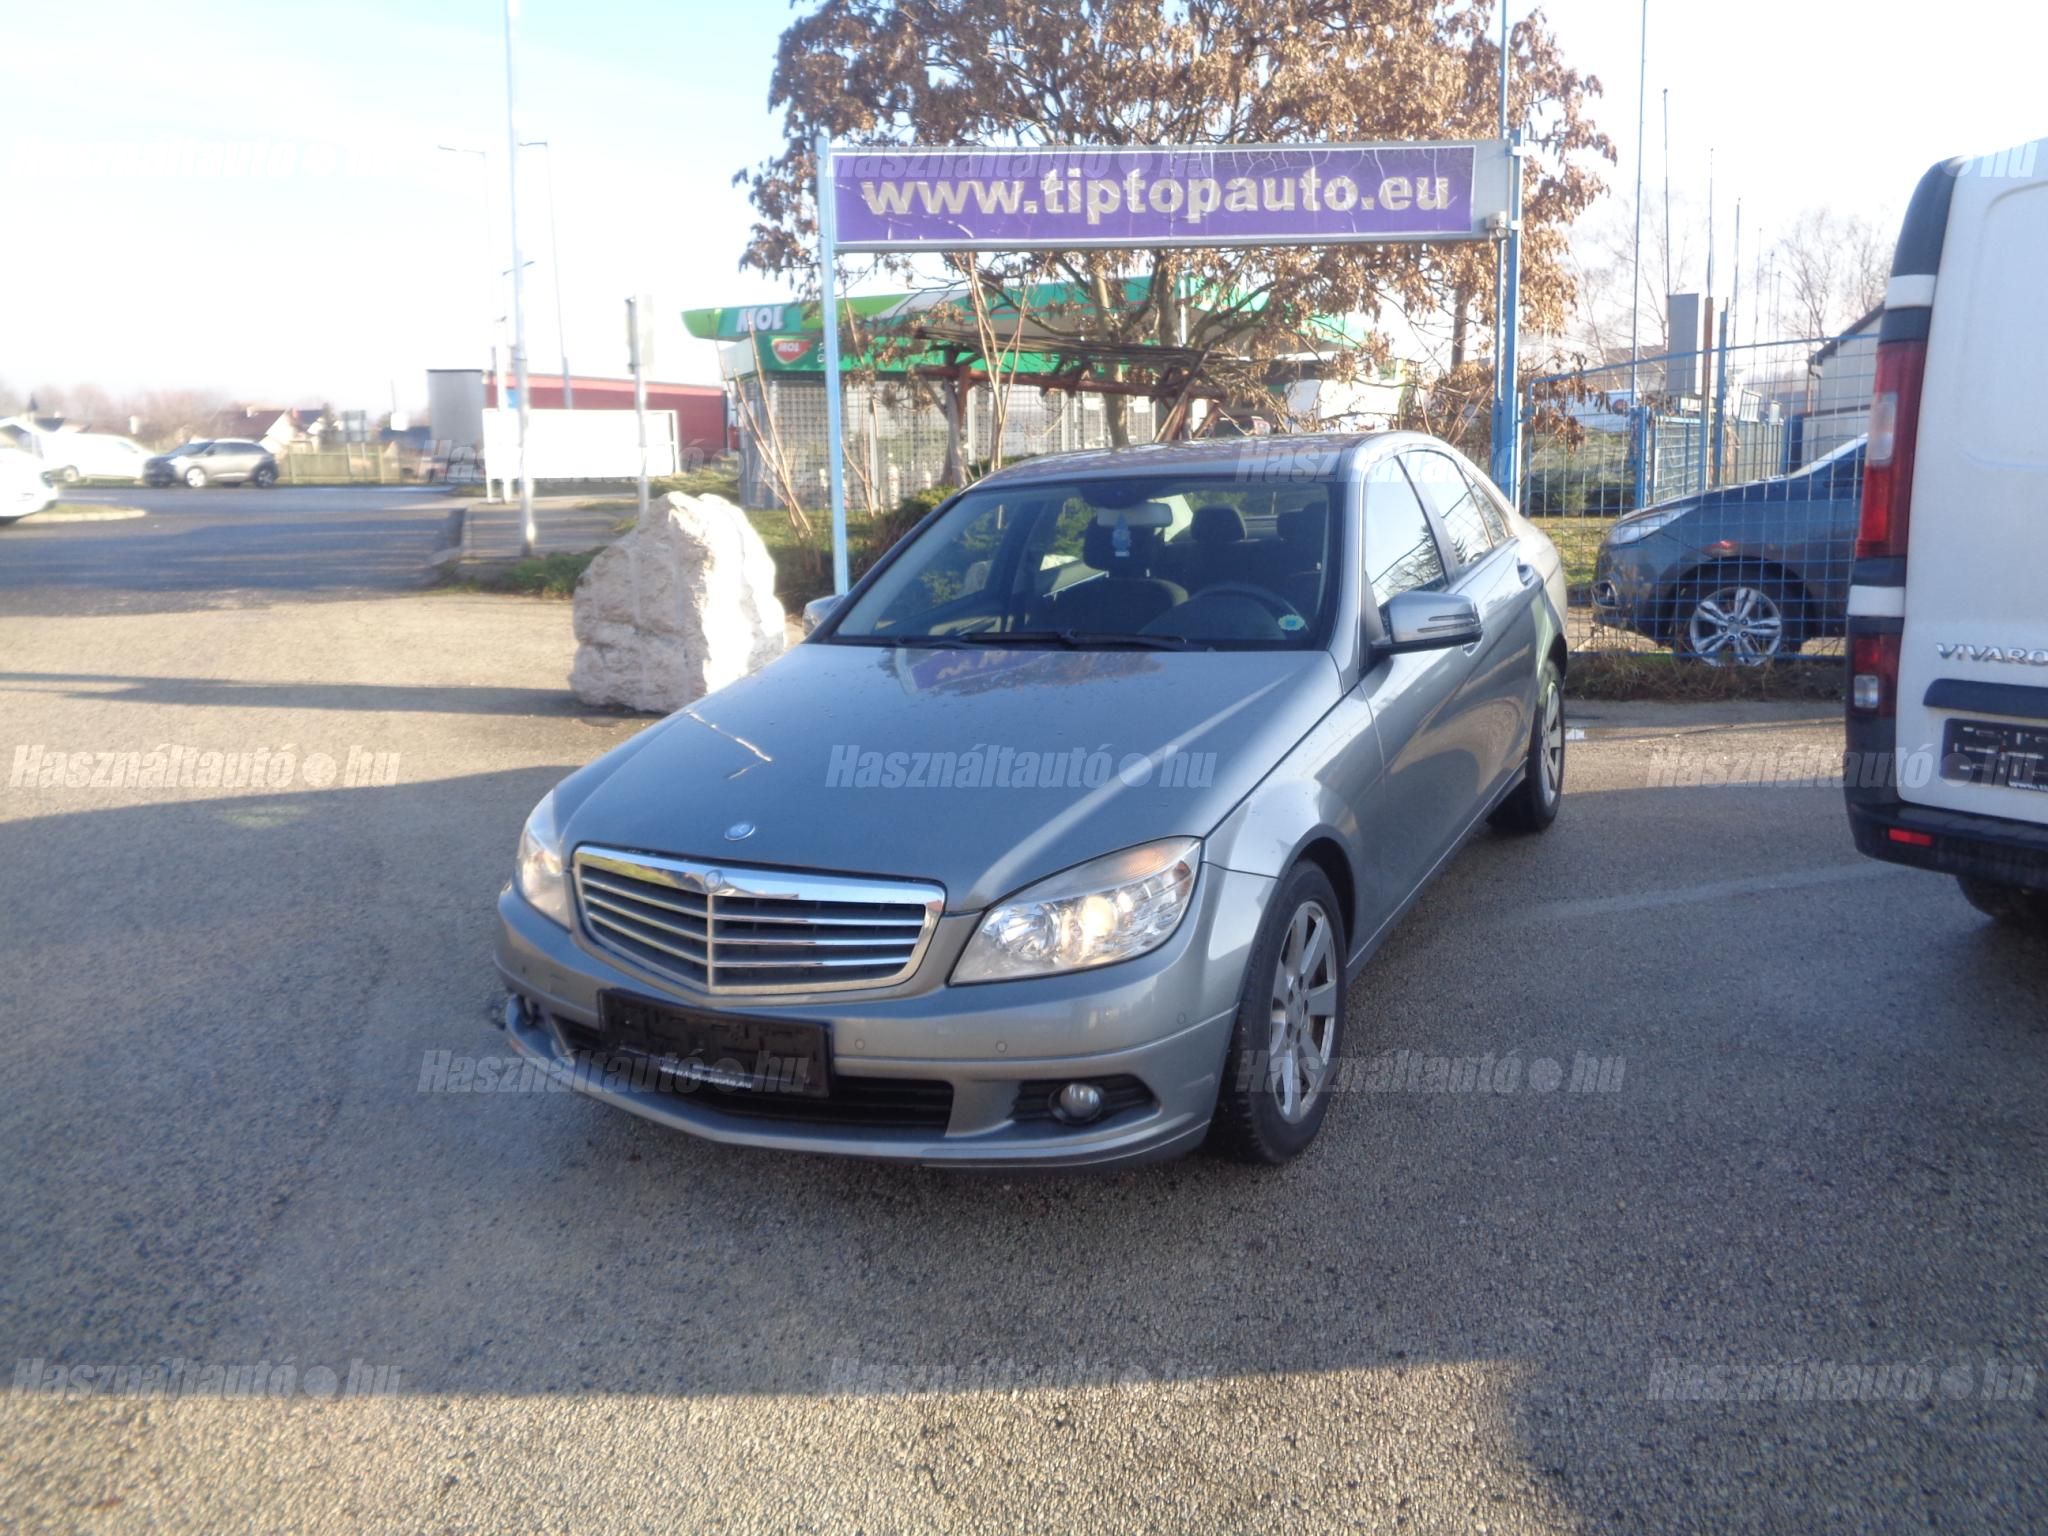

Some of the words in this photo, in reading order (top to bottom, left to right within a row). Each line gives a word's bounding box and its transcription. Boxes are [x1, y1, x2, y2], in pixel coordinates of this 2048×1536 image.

[862, 166, 1452, 225] www.tiptopauto.eu
[736, 305, 785, 333] MOL
[1936, 642, 2048, 666] VIVARO
